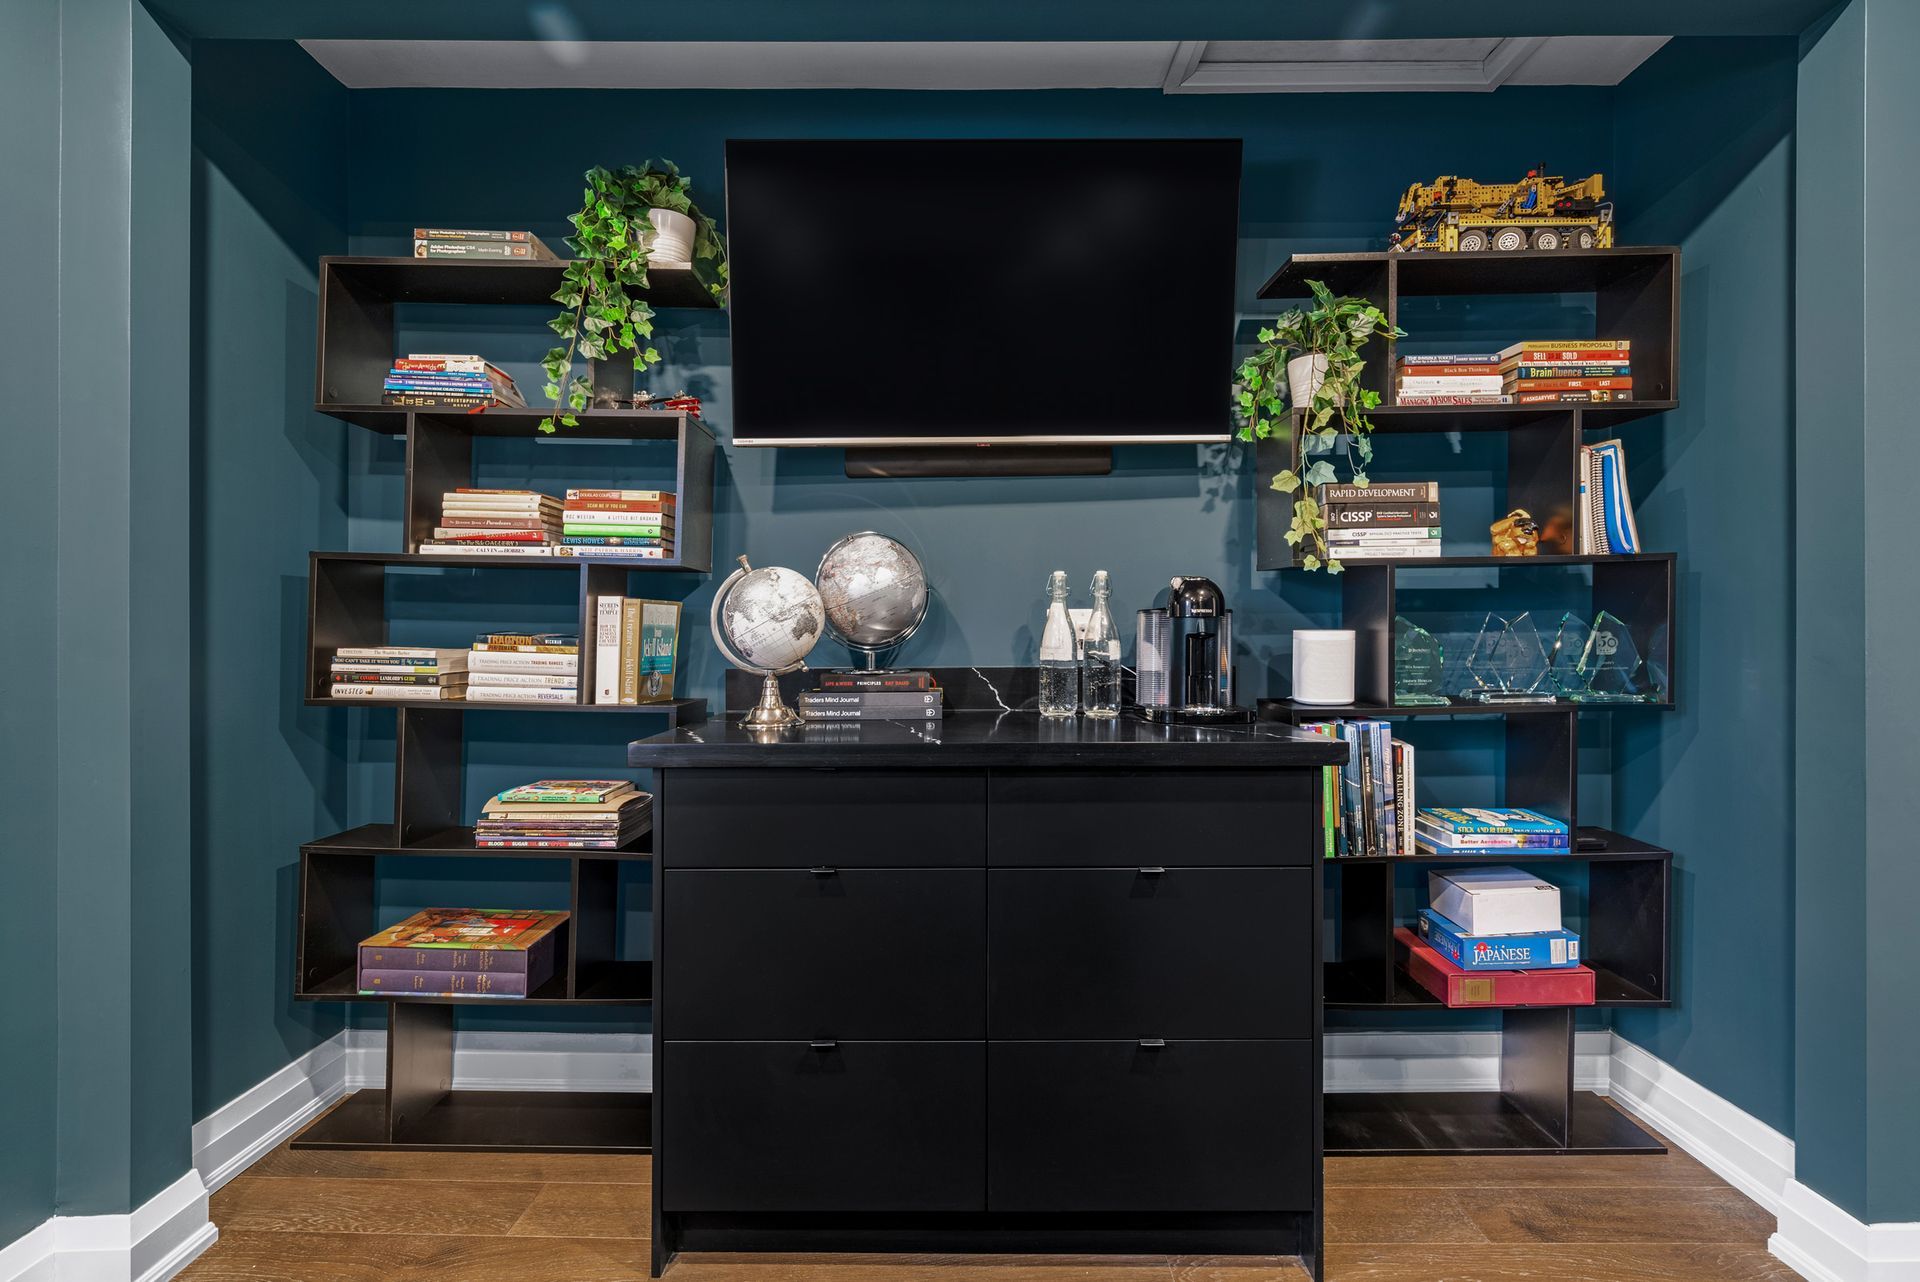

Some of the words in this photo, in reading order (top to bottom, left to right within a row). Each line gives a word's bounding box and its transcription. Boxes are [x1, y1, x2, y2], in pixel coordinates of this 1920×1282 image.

[1530, 368, 1582, 377] Brainfluence
[1453, 396, 1472, 404] SALES
[1358, 488, 1415, 497] DEVELOPMENT
[1341, 512, 1372, 522] CISSP
[488, 636, 532, 645] TRACTION
[1598, 635, 1616, 647] 50
[656, 638, 672, 656] Island
[625, 658, 634, 674] Jekyll
[625, 675, 633, 694] Island
[1473, 948, 1530, 965] JAPANESE
